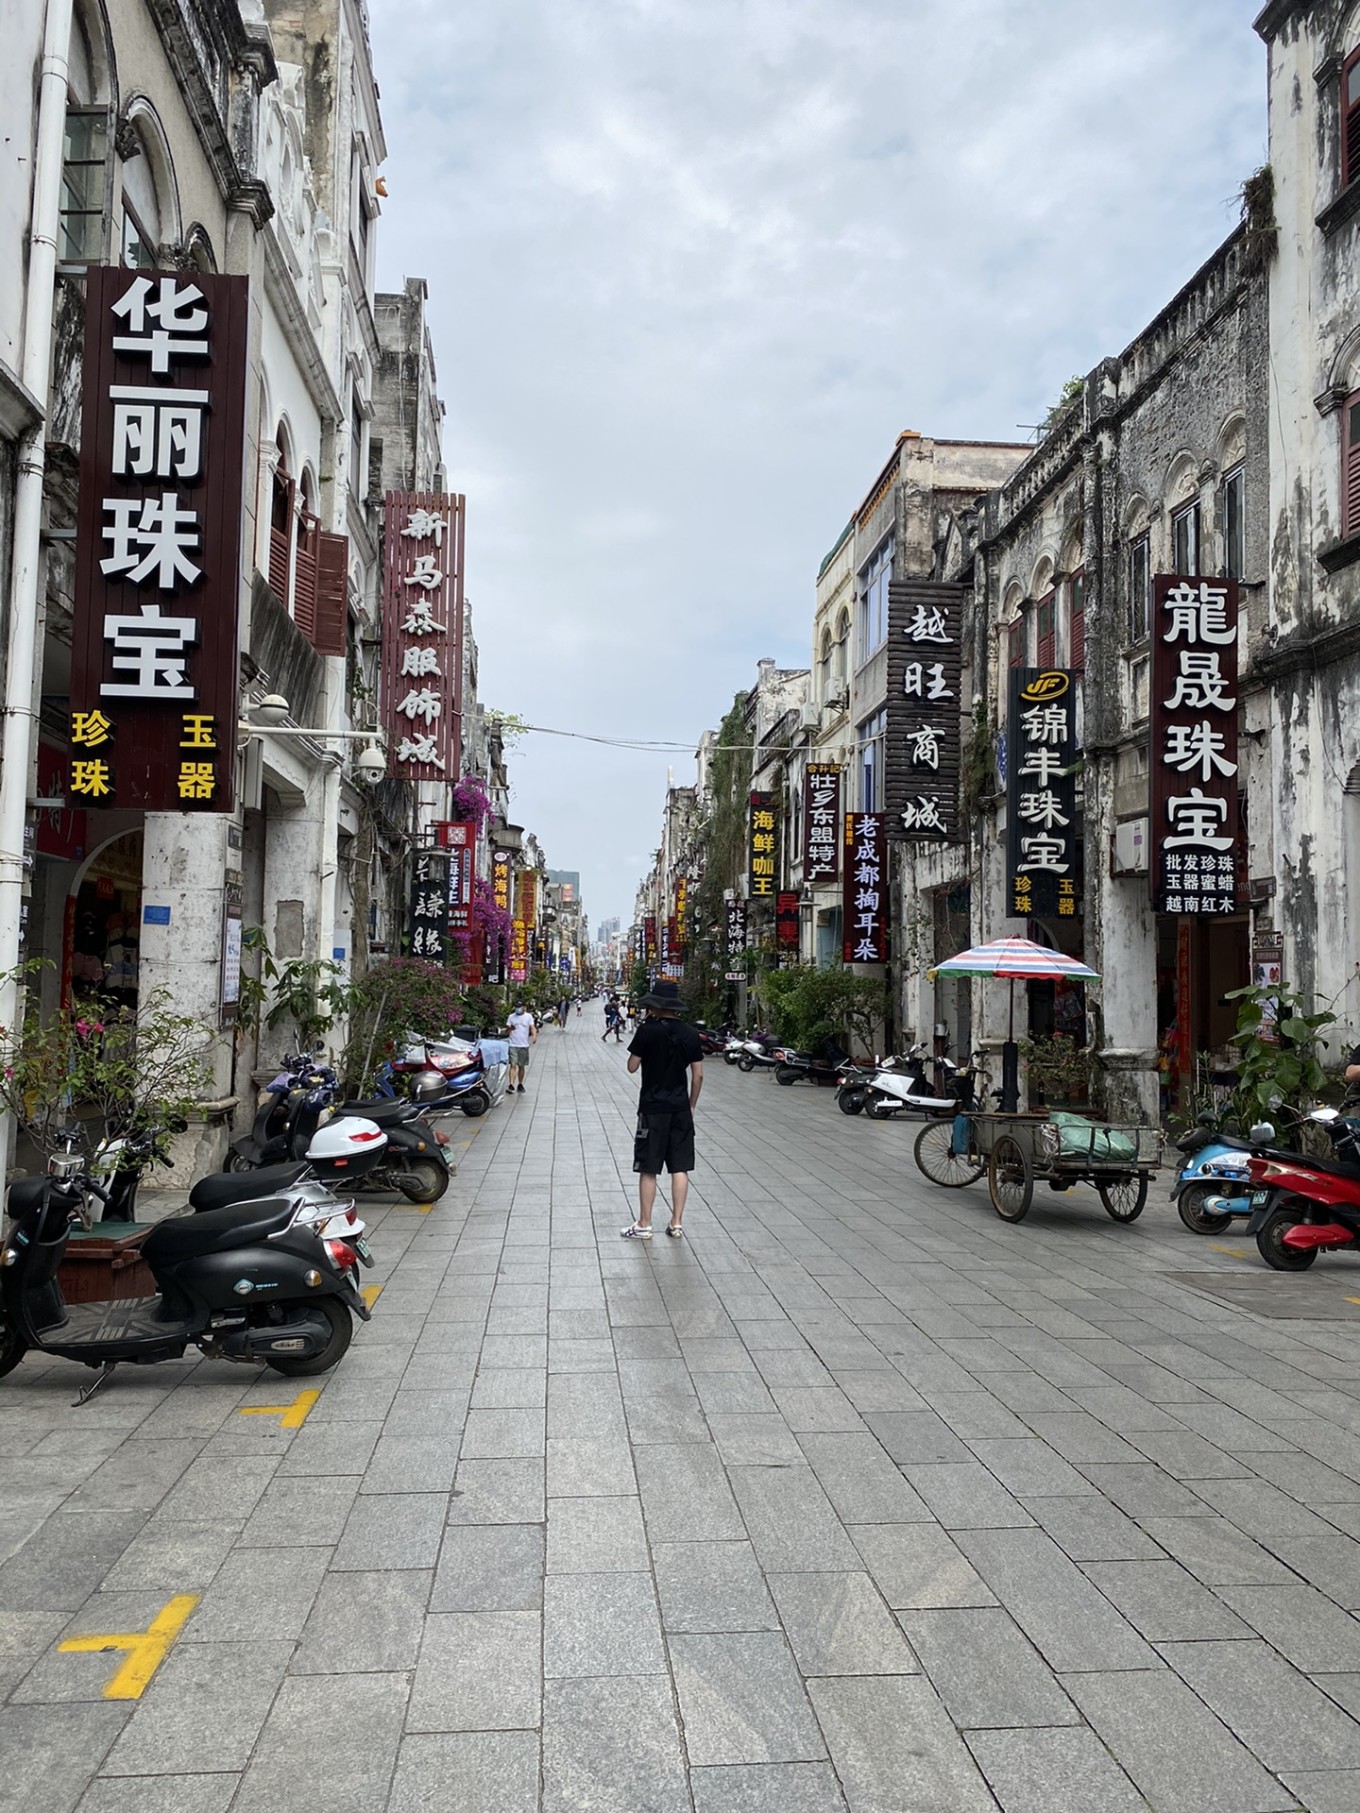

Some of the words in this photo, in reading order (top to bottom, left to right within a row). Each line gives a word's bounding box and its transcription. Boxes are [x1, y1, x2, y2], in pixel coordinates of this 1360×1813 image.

[100, 276, 209, 698] 华丽珠宝
[396, 508, 448, 771] 新马泰服饰城
[70, 710, 112, 797] 珍珠
[178, 714, 216, 799] 玉器
[901, 604, 955, 834] 越旺商城
[1163, 582, 1238, 851] 龍晟珠宝
[1017, 703, 1070, 874] 锦丰珠宝
[752, 811, 775, 895] 海鲜咖王
[853, 815, 880, 962] 老成都掏耳朵
[1015, 876, 1032, 912] 珍珠
[1165, 854, 1234, 871] 批发珍珠
[1166, 874, 1235, 891] 玉器蜜蜡
[1058, 879, 1075, 914] 玉器
[1166, 895, 1234, 913] 越南红木
